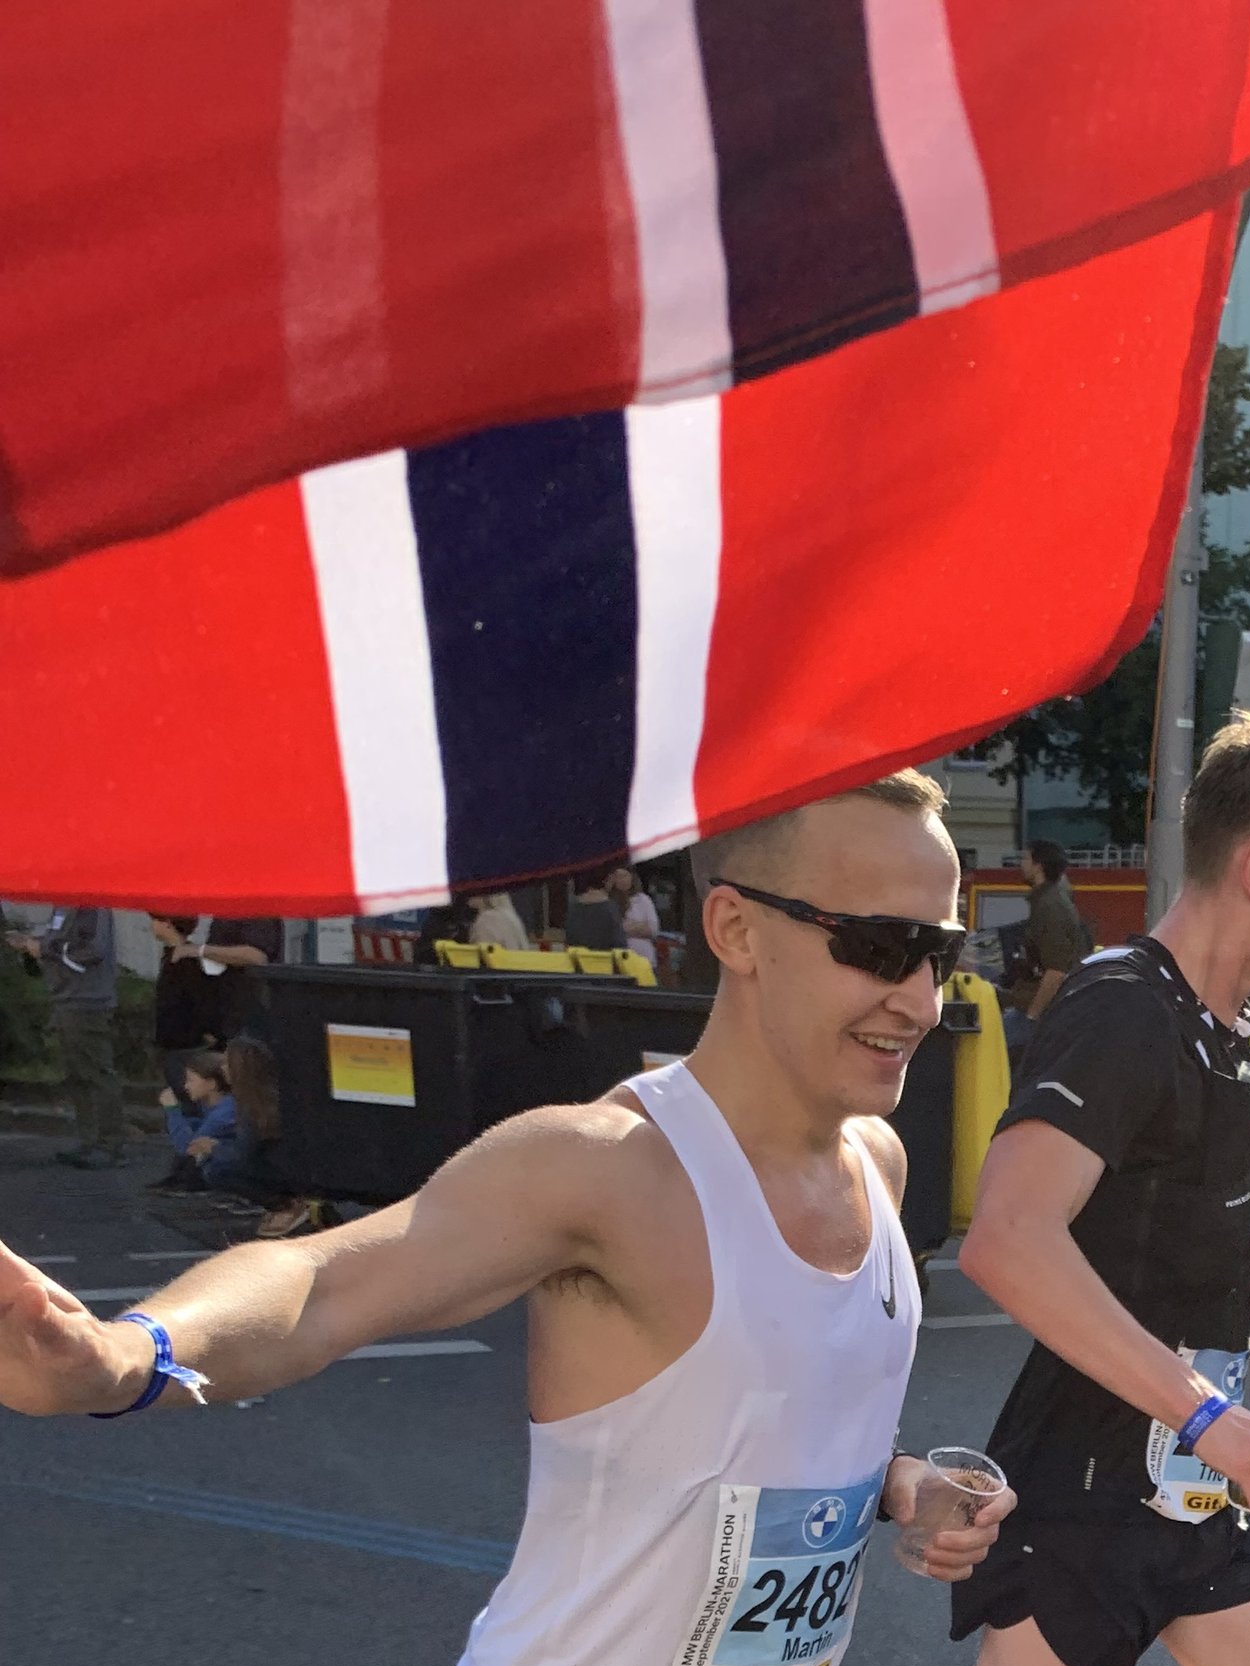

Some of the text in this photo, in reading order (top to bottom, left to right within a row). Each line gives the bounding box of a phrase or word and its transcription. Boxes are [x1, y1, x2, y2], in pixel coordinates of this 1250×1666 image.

[690, 1514, 736, 1642] BERLIN-MARATHON
[714, 1590, 734, 1616] 2021
[730, 1538, 869, 1633] 2482
[781, 1631, 833, 1662] Martin
